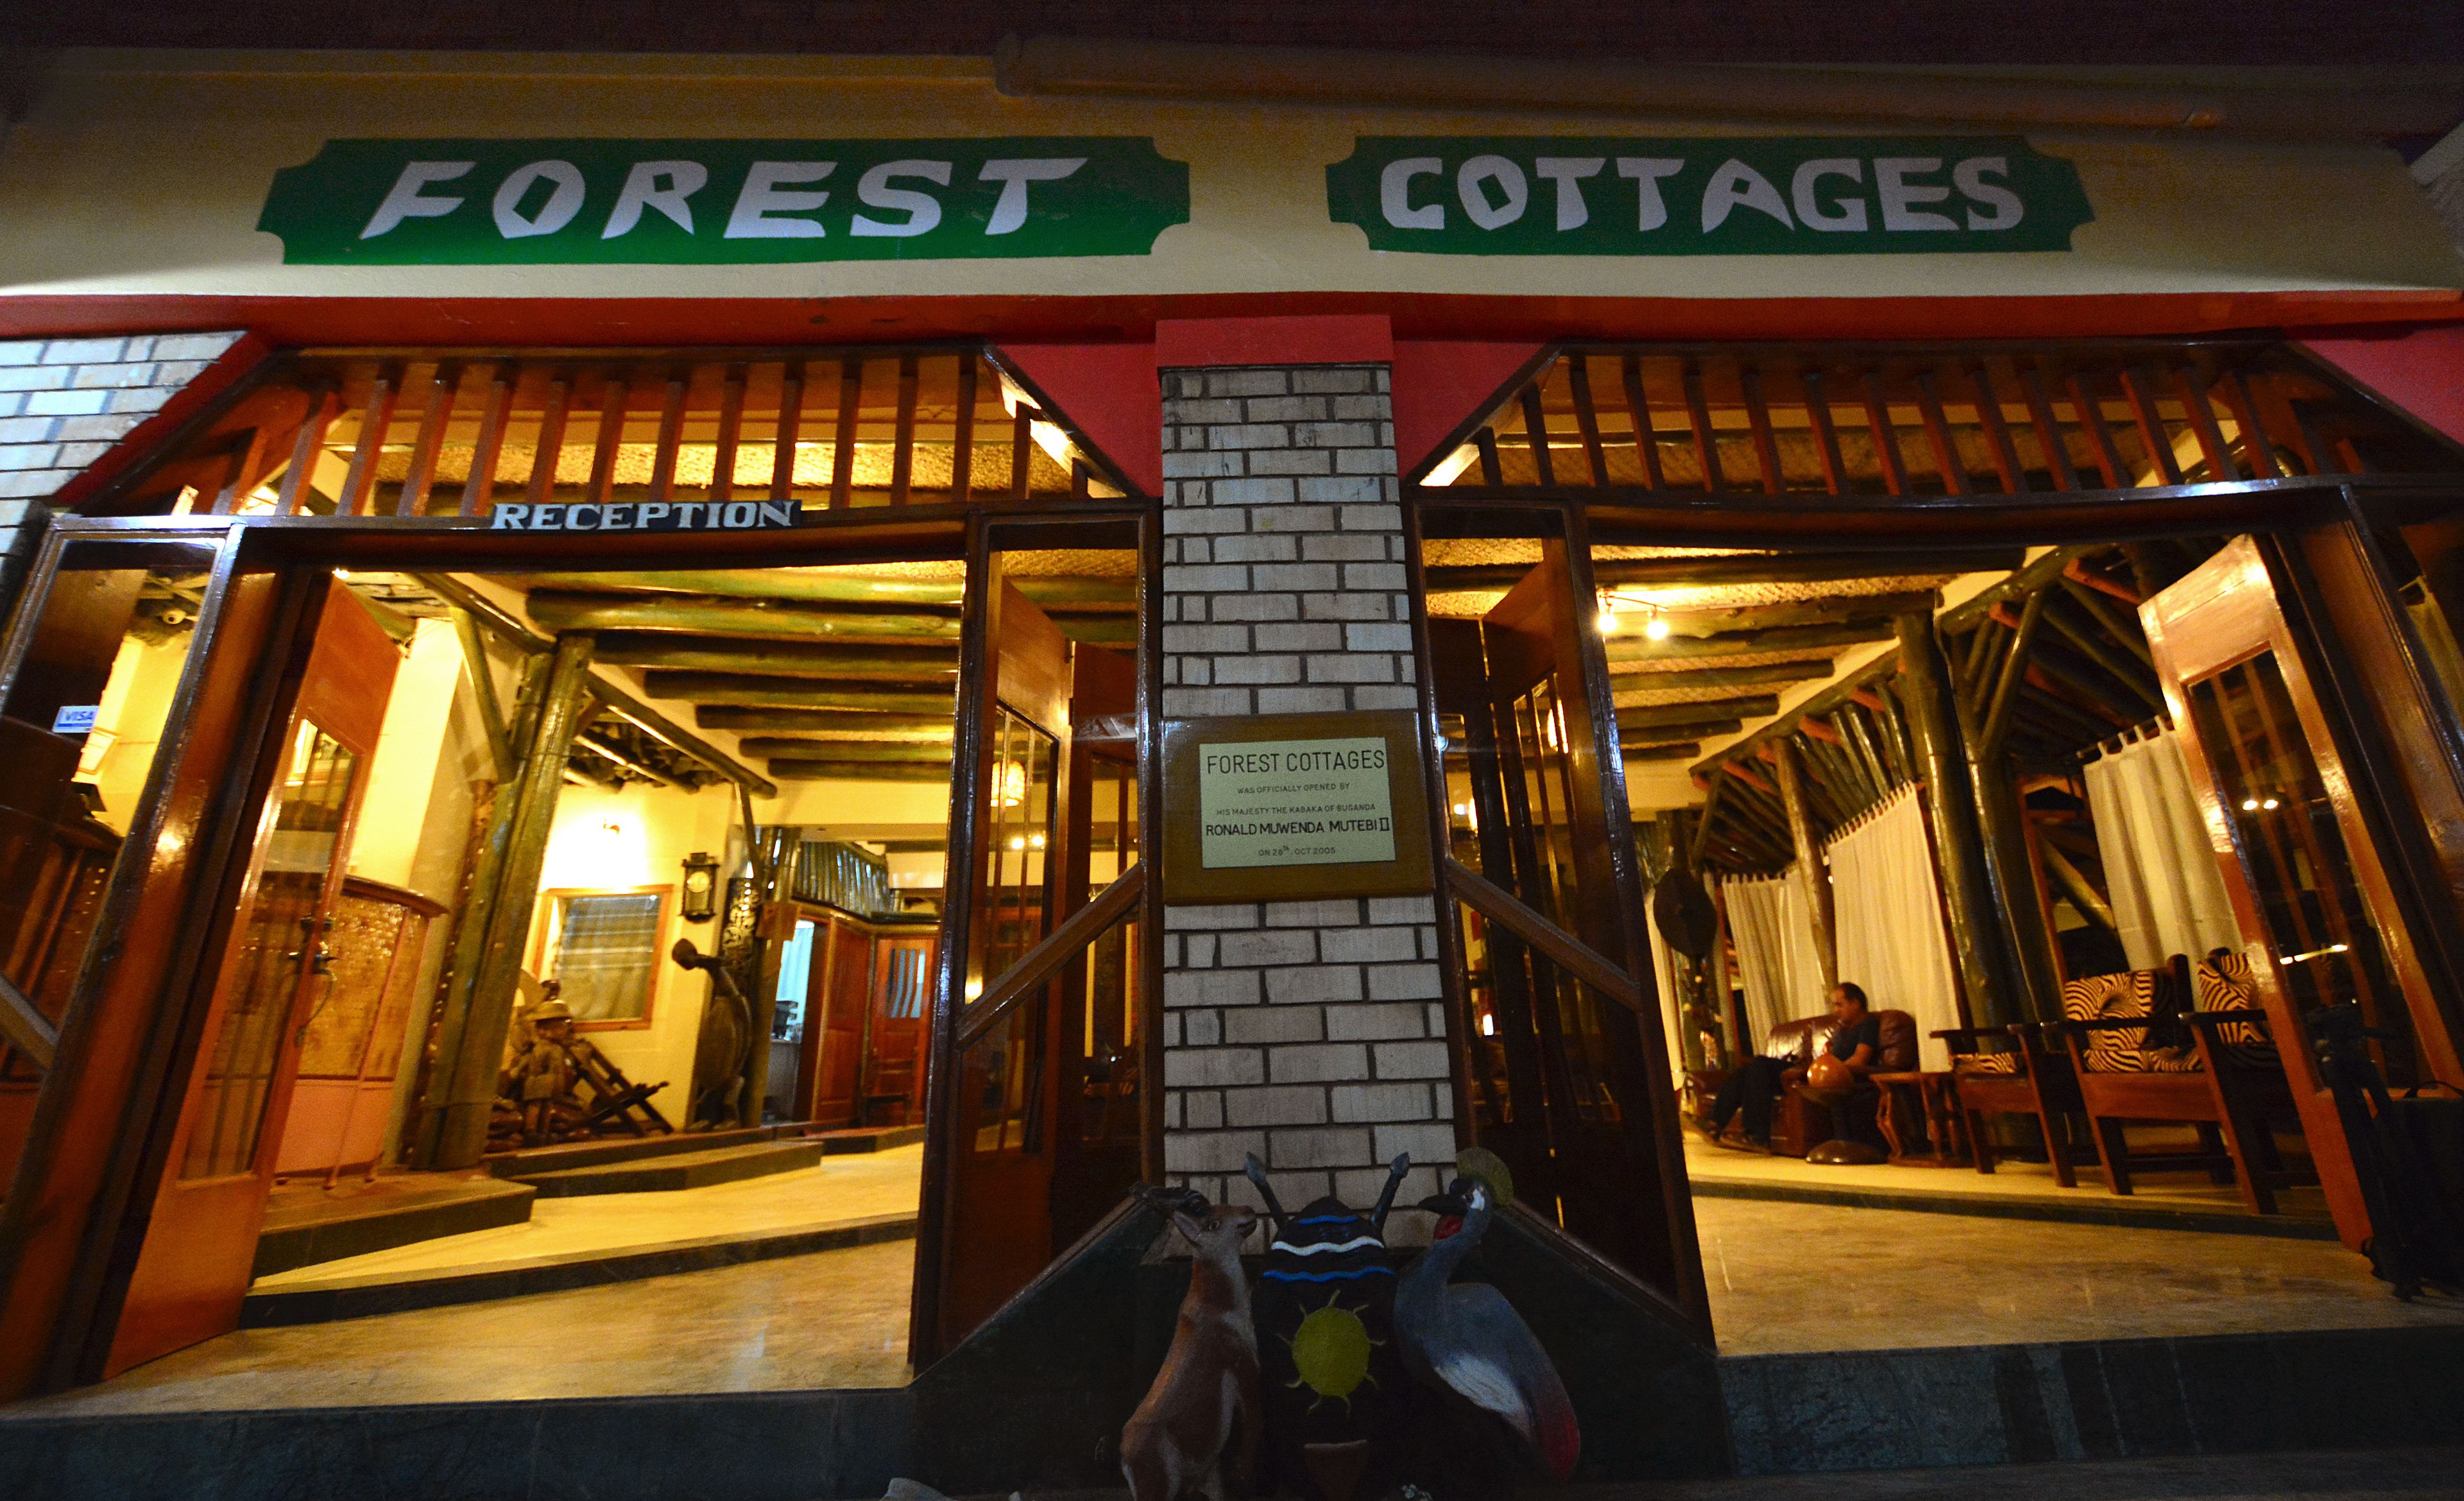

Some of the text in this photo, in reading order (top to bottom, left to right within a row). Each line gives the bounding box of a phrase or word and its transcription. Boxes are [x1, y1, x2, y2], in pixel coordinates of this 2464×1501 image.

[359, 155, 2024, 242] FOREST COTTAGES
[491, 501, 794, 531] RECEPTION
[1208, 750, 1385, 774] FOREST COTTAGES
[1256, 785, 1302, 794] OFFICIALLY
[1289, 805, 1323, 814] KABAKA
[1337, 803, 1376, 812] BUGANDA
[1206, 823, 1257, 836] RONALD
[1260, 821, 1325, 834] MUWENDA
[1329, 819, 1378, 832] MUTEBI
[1313, 846, 1336, 855] 2005
